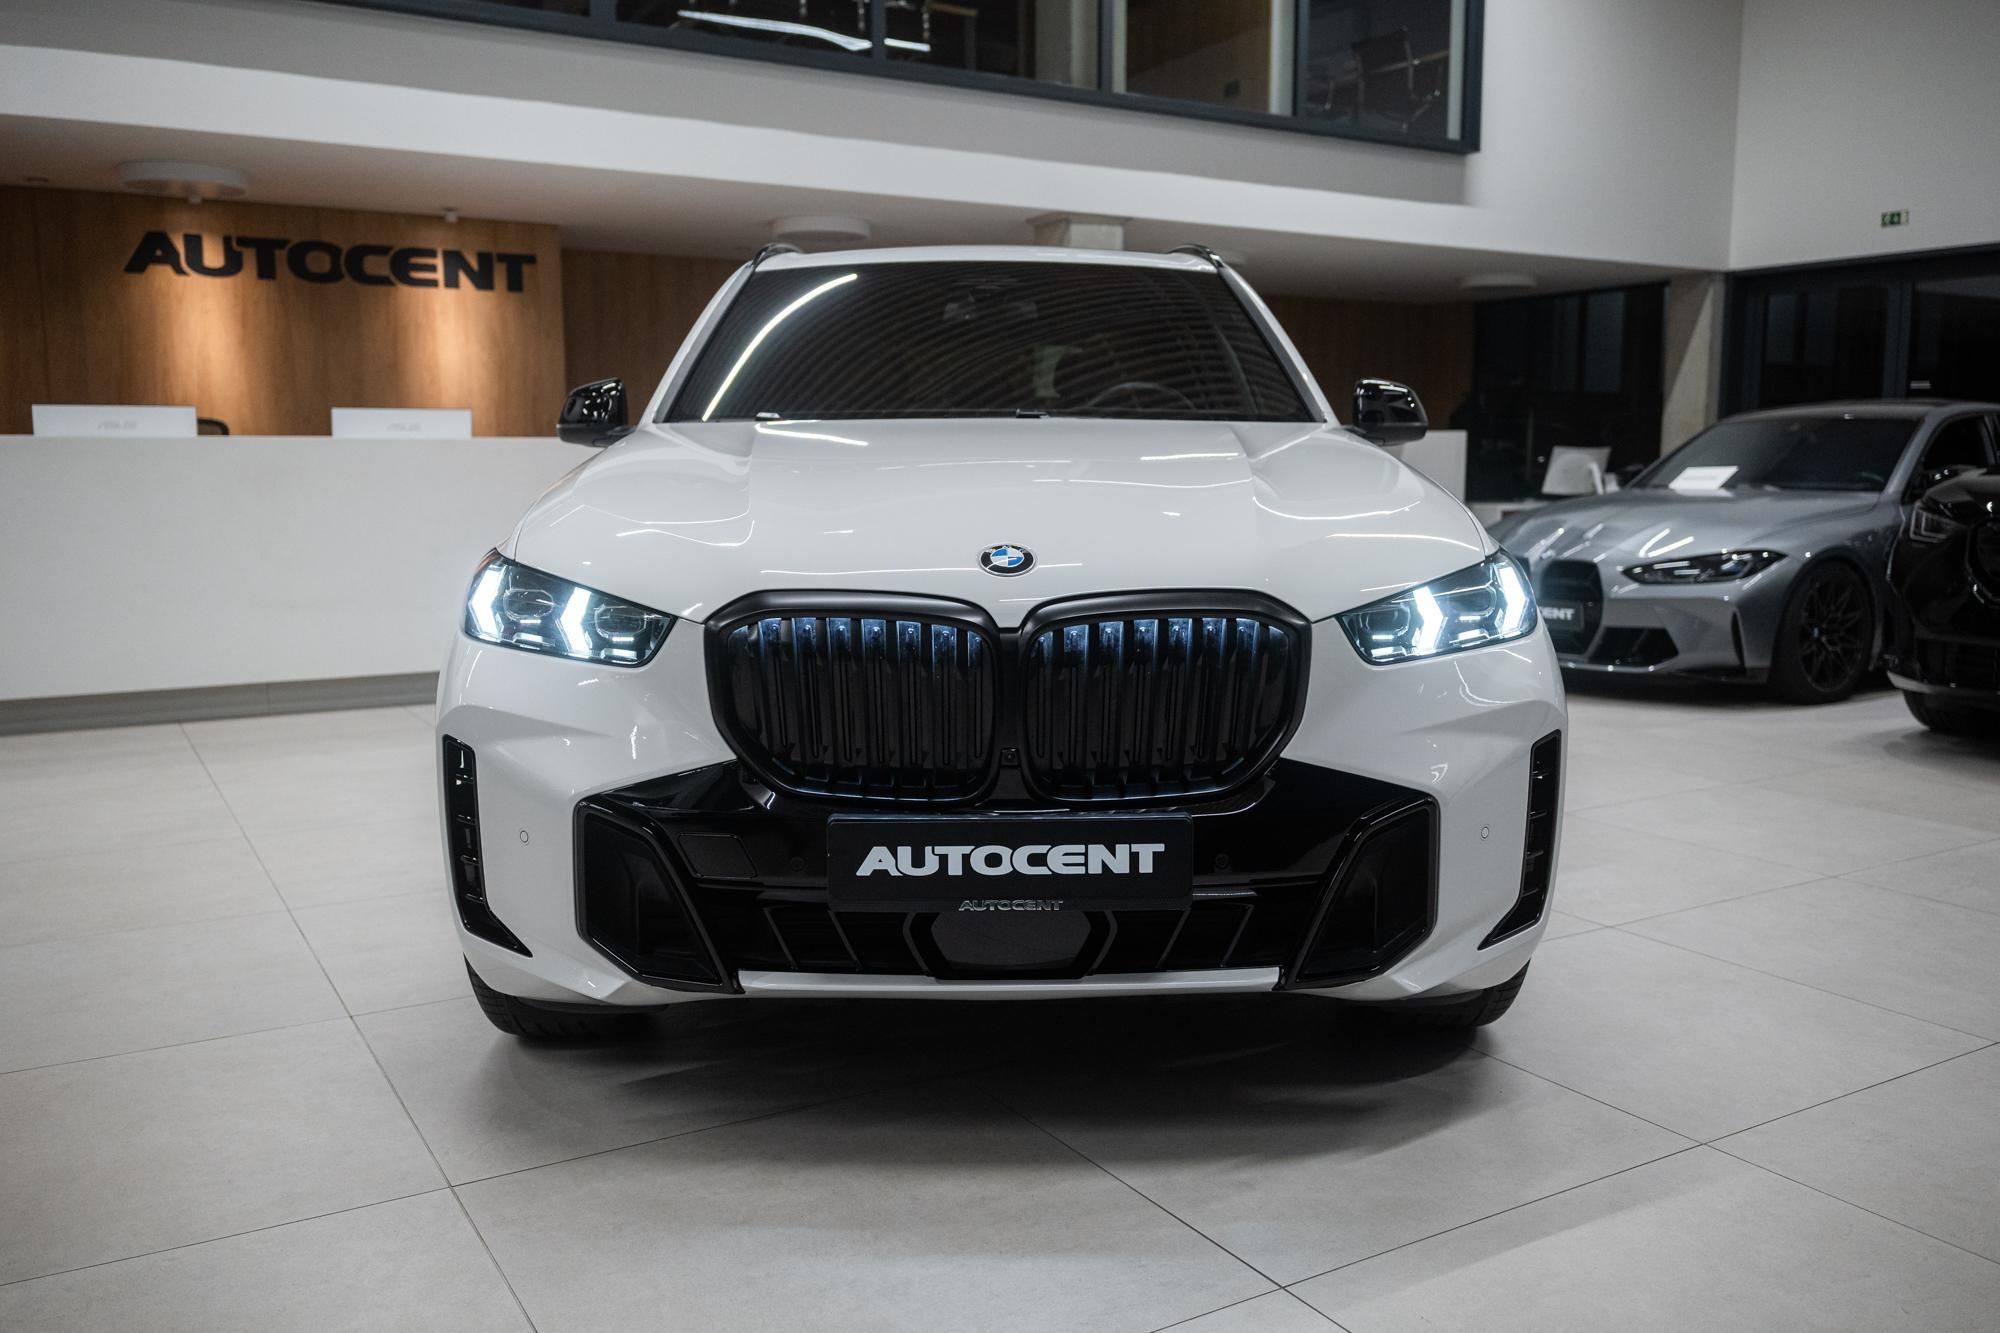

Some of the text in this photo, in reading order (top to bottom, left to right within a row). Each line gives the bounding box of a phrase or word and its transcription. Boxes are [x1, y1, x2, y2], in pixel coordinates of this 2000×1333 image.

[124, 231, 537, 293] AUTOCENT
[1538, 606, 1575, 620] ENT
[856, 843, 1165, 876] AUTOCENT
[958, 899, 1064, 912] AUTOCENT
